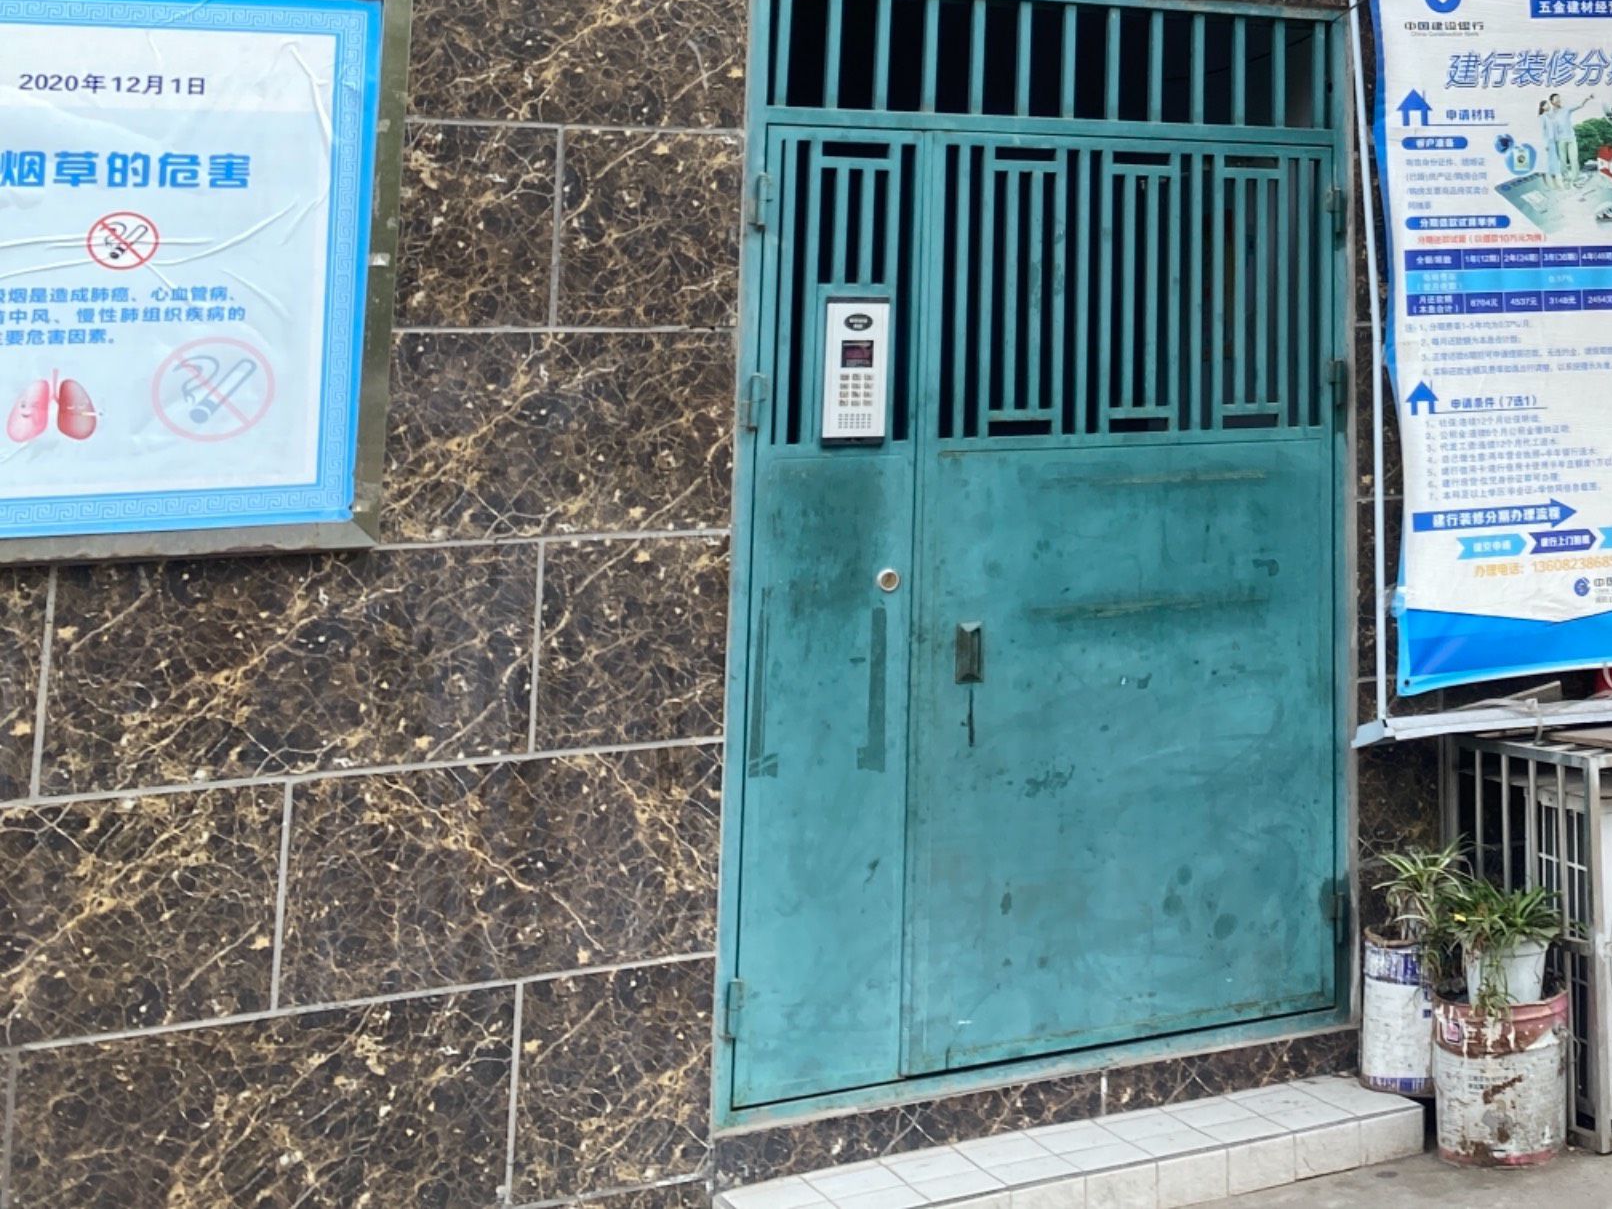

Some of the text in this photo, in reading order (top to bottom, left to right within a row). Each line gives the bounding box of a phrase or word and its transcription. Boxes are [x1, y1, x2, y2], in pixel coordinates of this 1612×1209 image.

[1404, 21, 1485, 31] 中国建设银行
[18, 73, 206, 96] 2020年12月1日
[1446, 109, 1496, 121] 申请材料
[0, 150, 251, 189] 烟草的危害
[0, 286, 236, 304] 烟是造成肺癌、心血管病、
[0, 306, 246, 325] 中风、慢性肺组织疾病的
[1432, 506, 1561, 528] 建行装修分期办理流程
